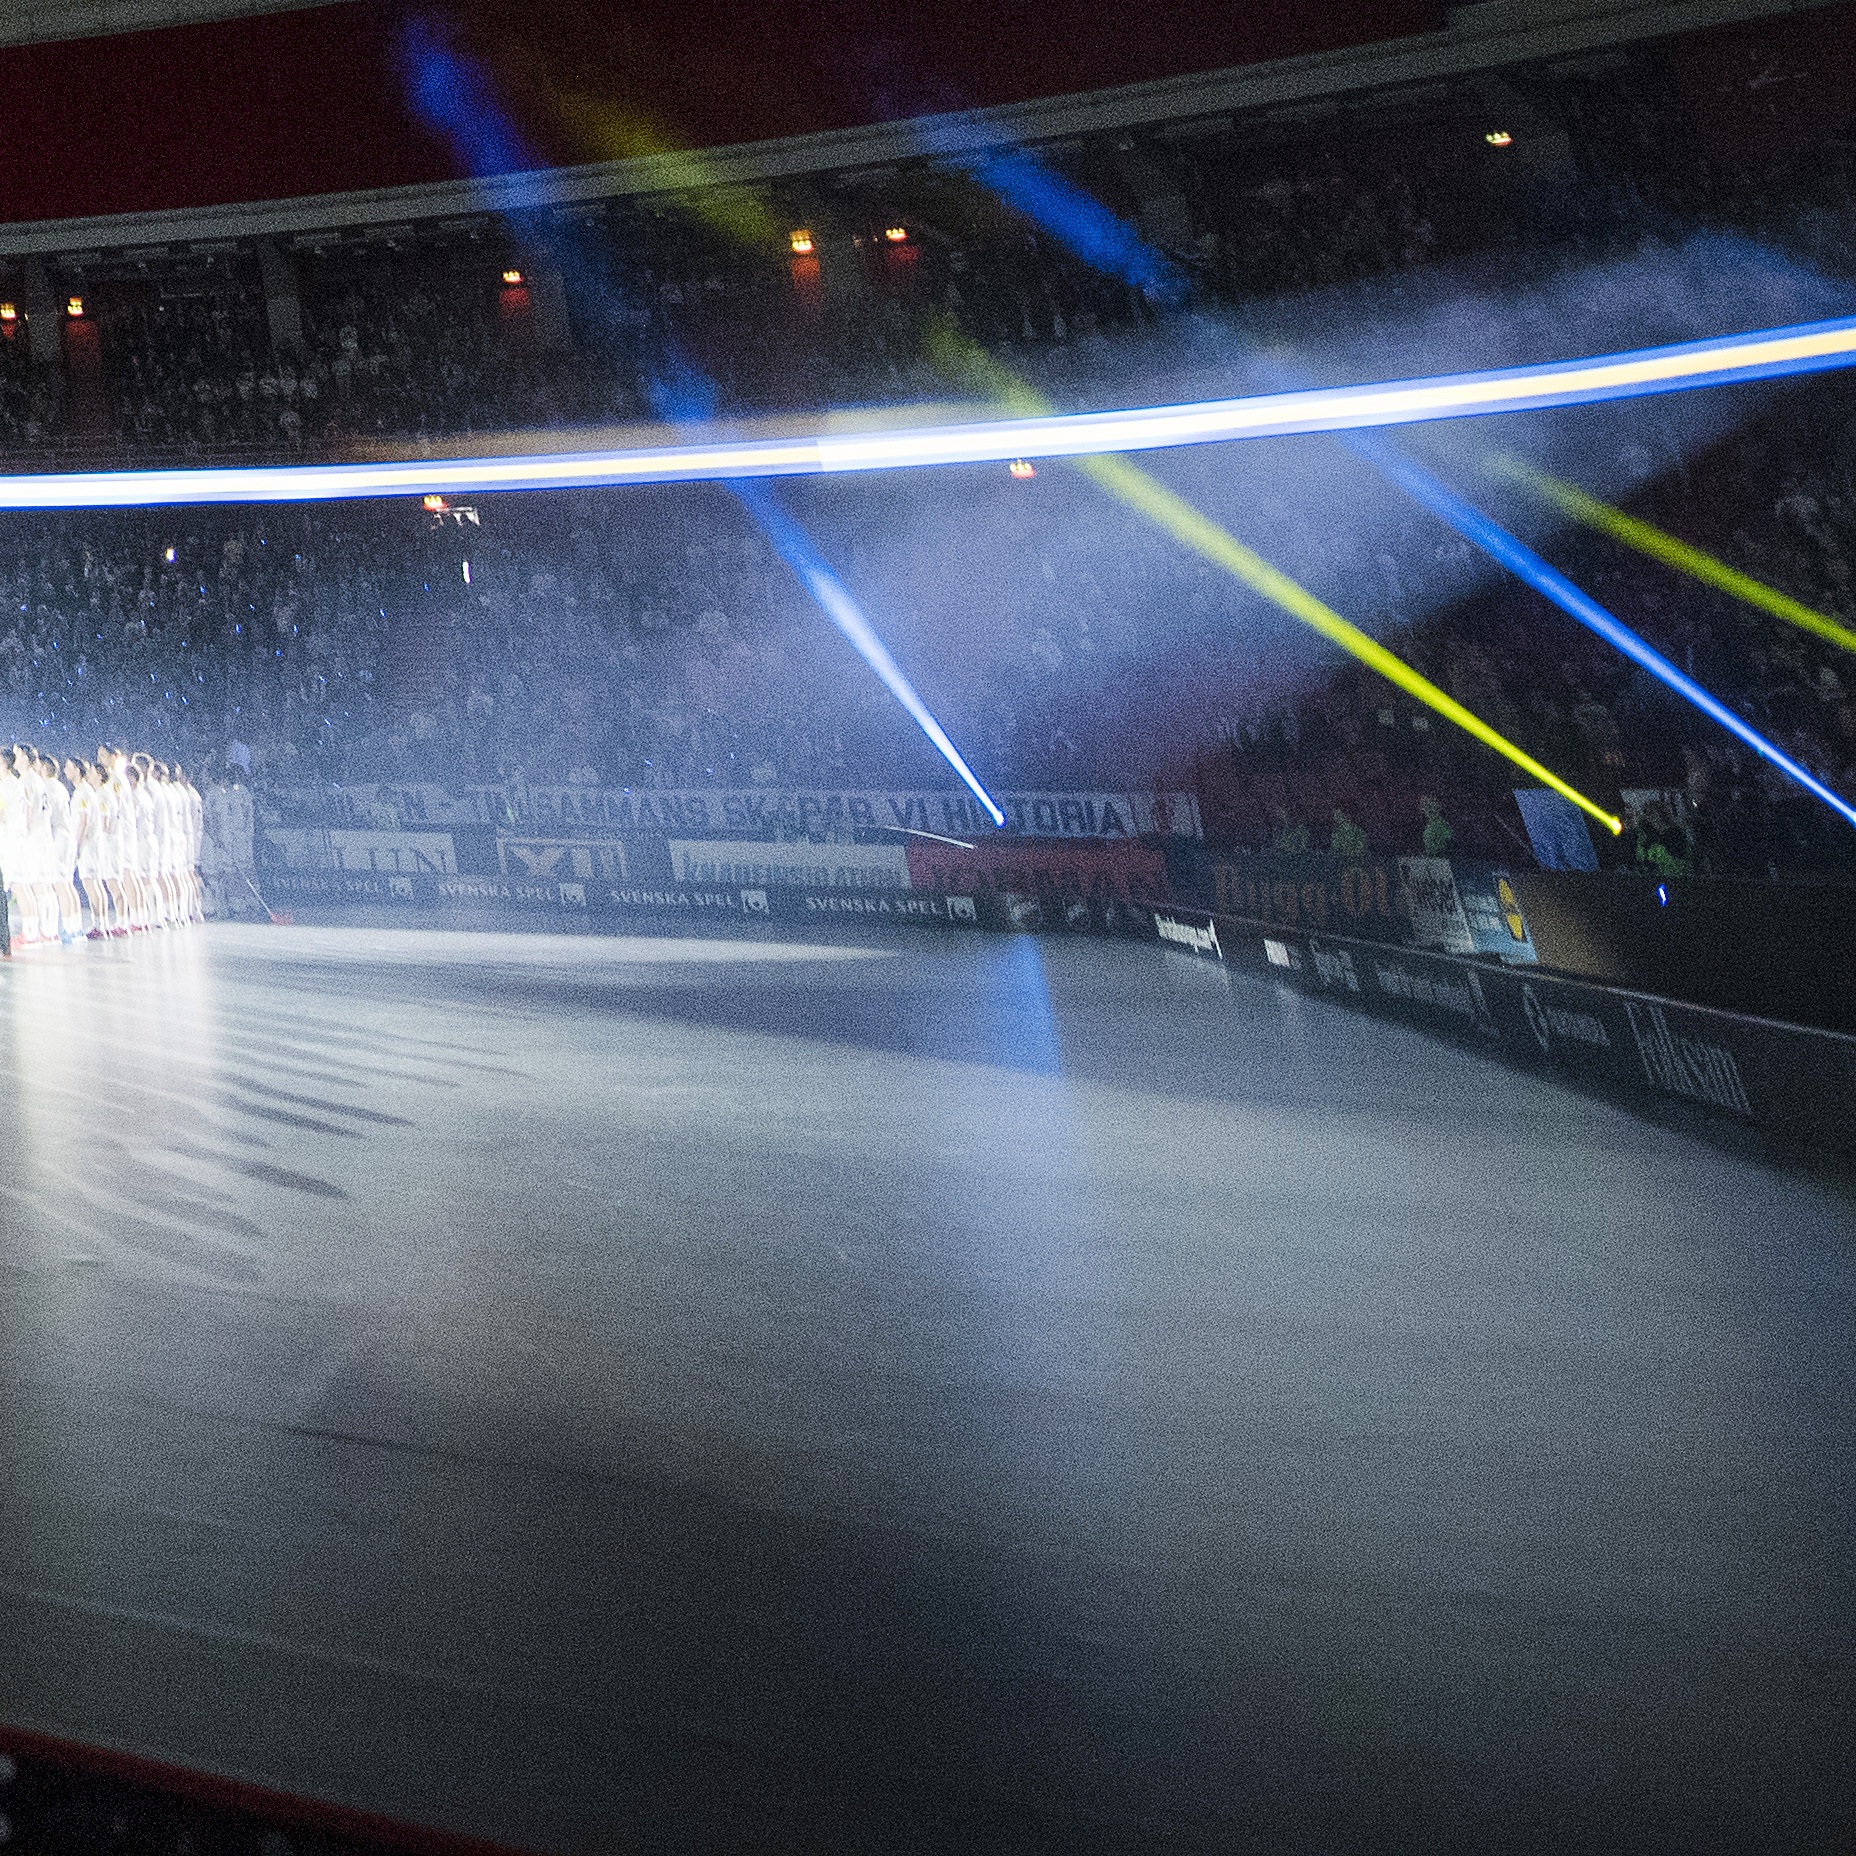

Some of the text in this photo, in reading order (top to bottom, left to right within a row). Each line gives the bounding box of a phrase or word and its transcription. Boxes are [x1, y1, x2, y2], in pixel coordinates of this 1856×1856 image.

[888, 798, 929, 831] VI
[943, 797, 1130, 836] HITORIA
[610, 889, 736, 909] SVENSKA SPEL
[805, 896, 943, 916] SVENSKA SPEL
